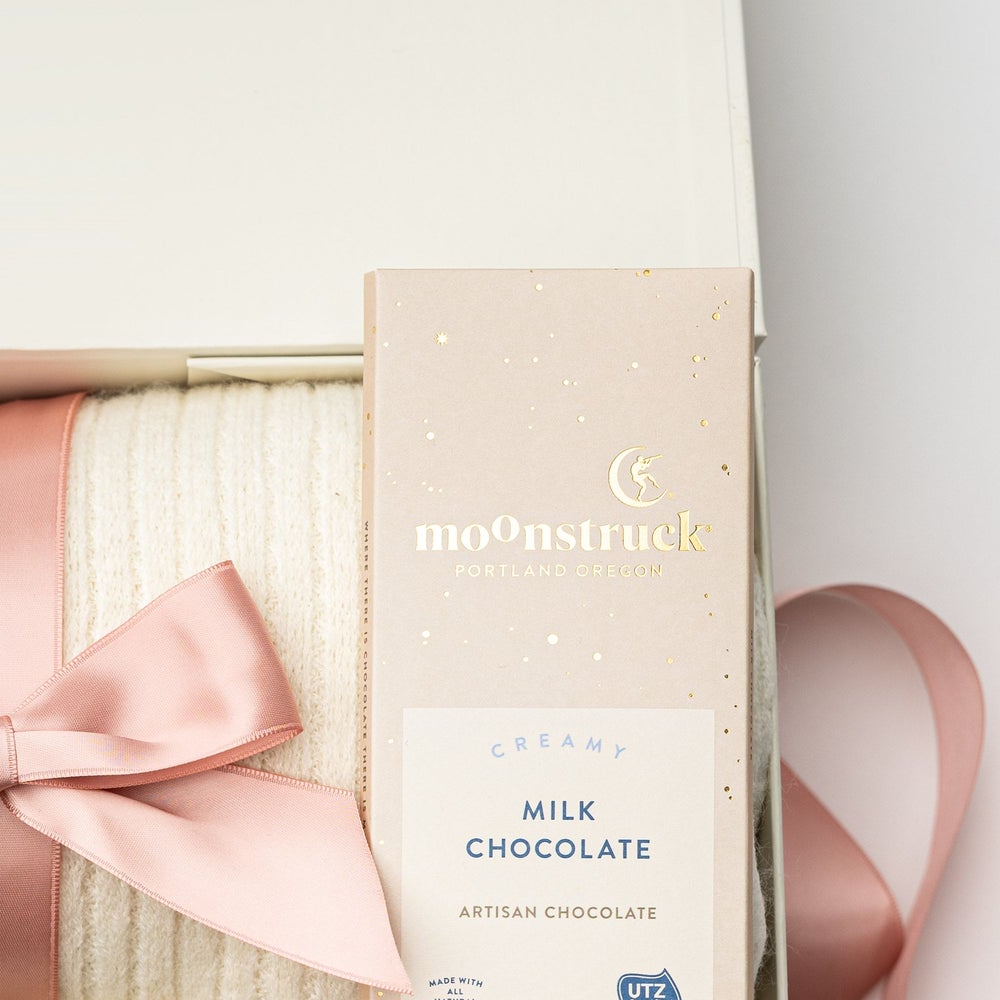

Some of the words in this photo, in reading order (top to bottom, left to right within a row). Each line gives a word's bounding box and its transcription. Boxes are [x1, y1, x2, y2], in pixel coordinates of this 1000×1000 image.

[415, 510, 707, 551] moonstruck
[455, 564, 566, 578] PORTLAND
[576, 564, 663, 578] OREGON
[490, 732, 627, 760] CREAMY
[522, 800, 596, 821] MILK
[466, 838, 651, 860] CHOCOLATE
[459, 905, 537, 919] ARTISAN
[544, 906, 657, 920] CHOCOLATE
[429, 977, 455, 987] MADE
[458, 977, 483, 987] WITH
[628, 983, 666, 998] UTZ
